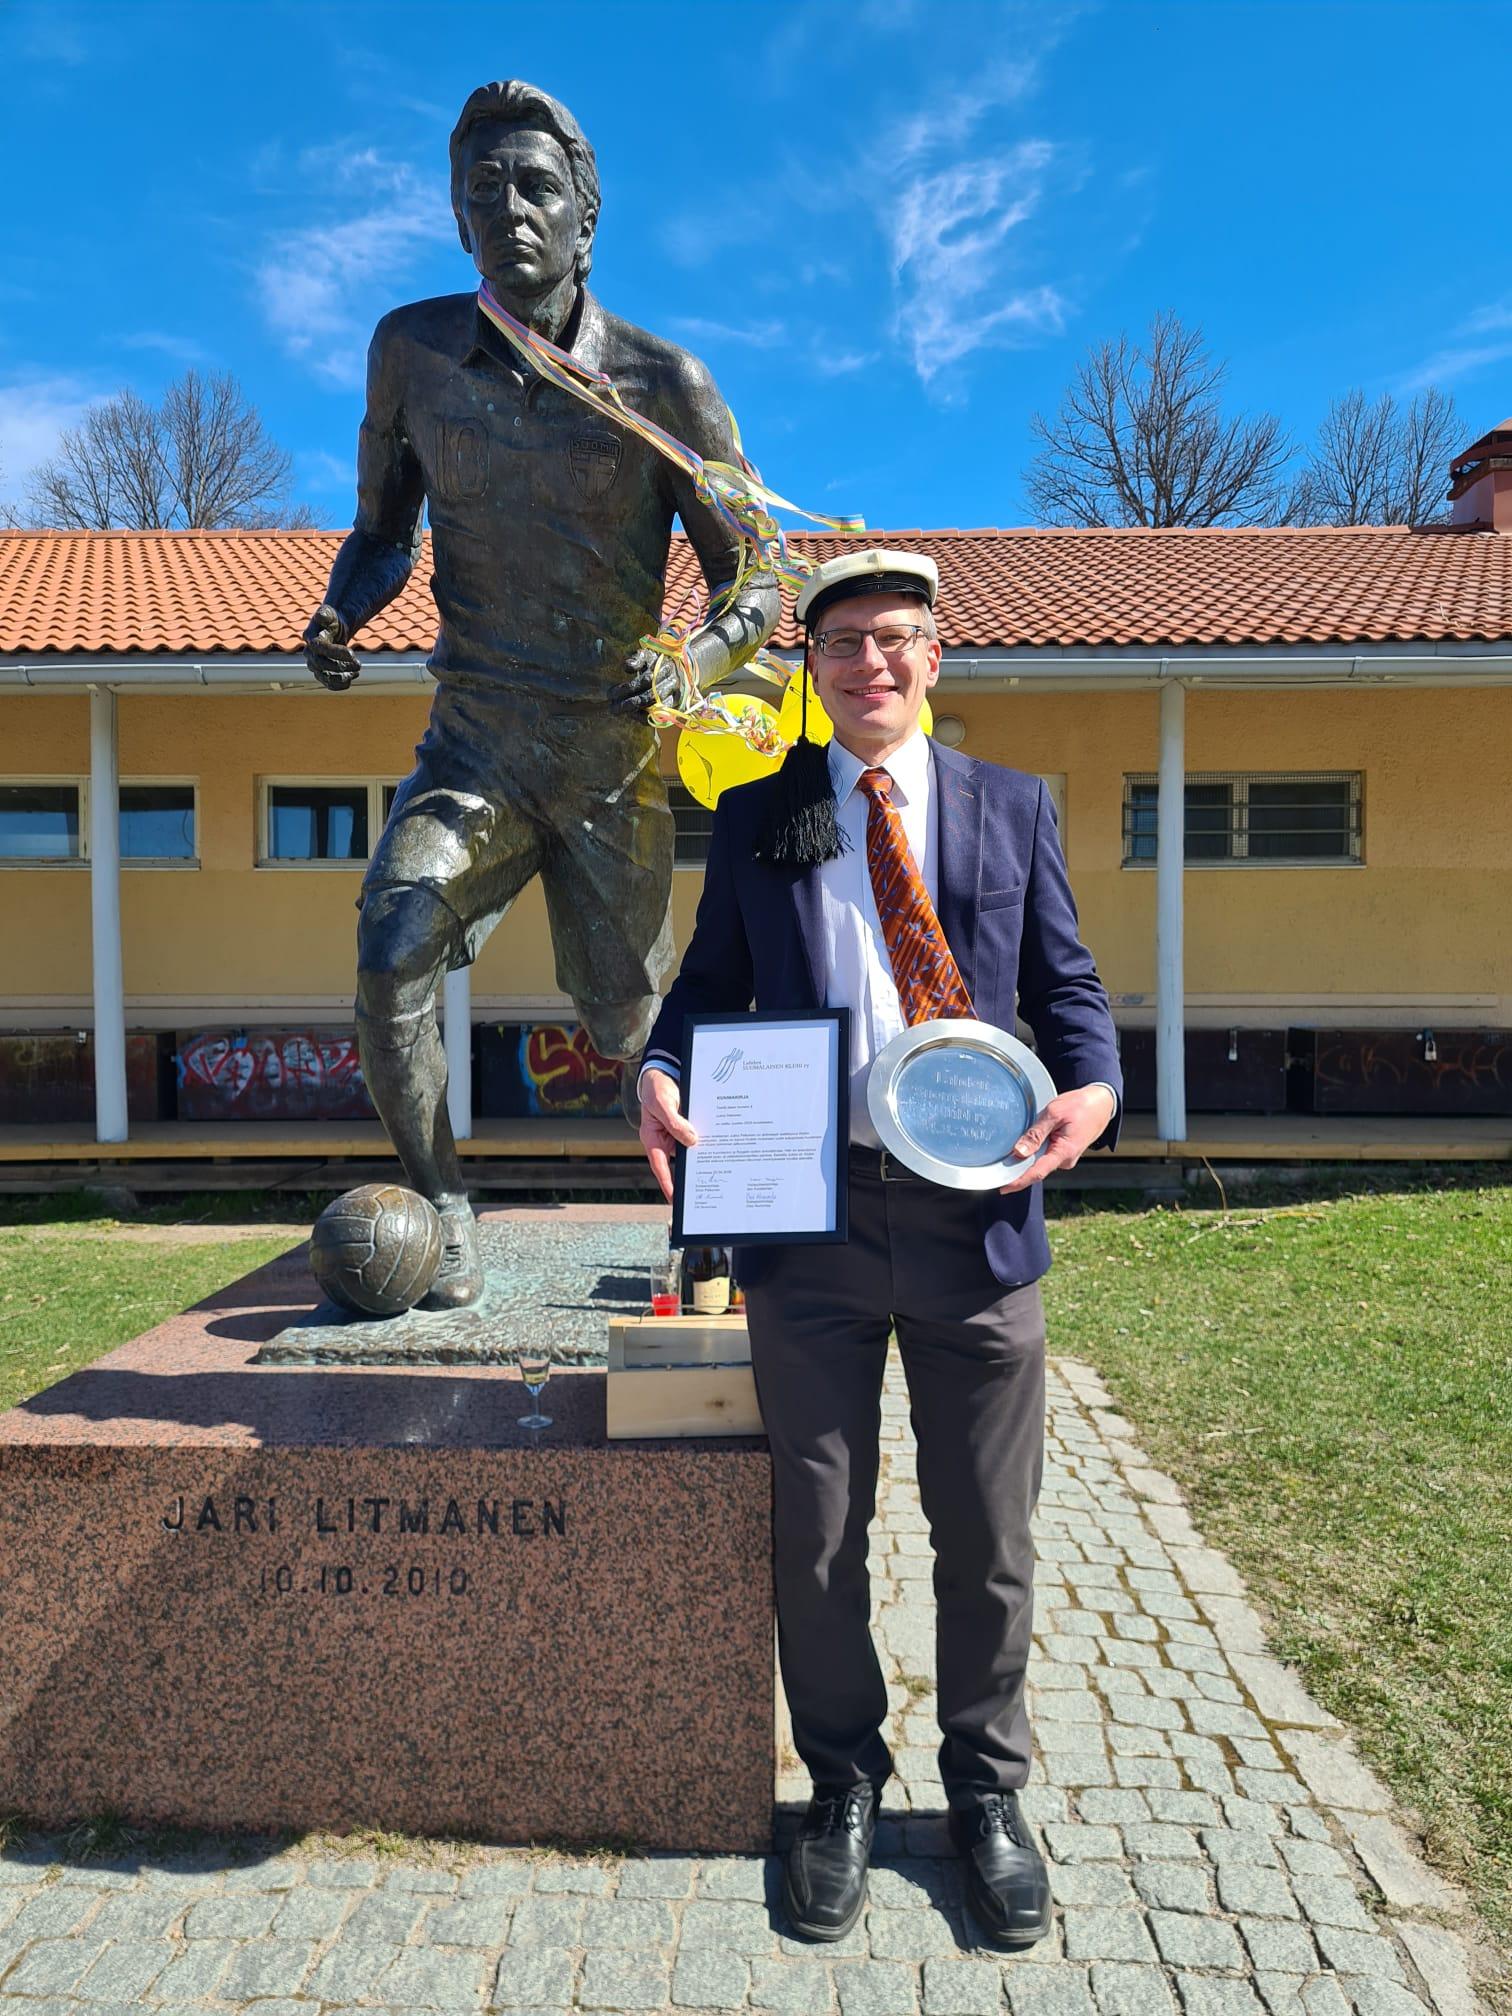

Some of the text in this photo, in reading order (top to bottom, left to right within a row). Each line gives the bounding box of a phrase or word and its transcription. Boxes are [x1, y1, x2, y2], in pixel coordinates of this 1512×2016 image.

[162, 1495, 567, 1536] JARI LITMANEN
[260, 1564, 469, 1596] 10.10.2010
